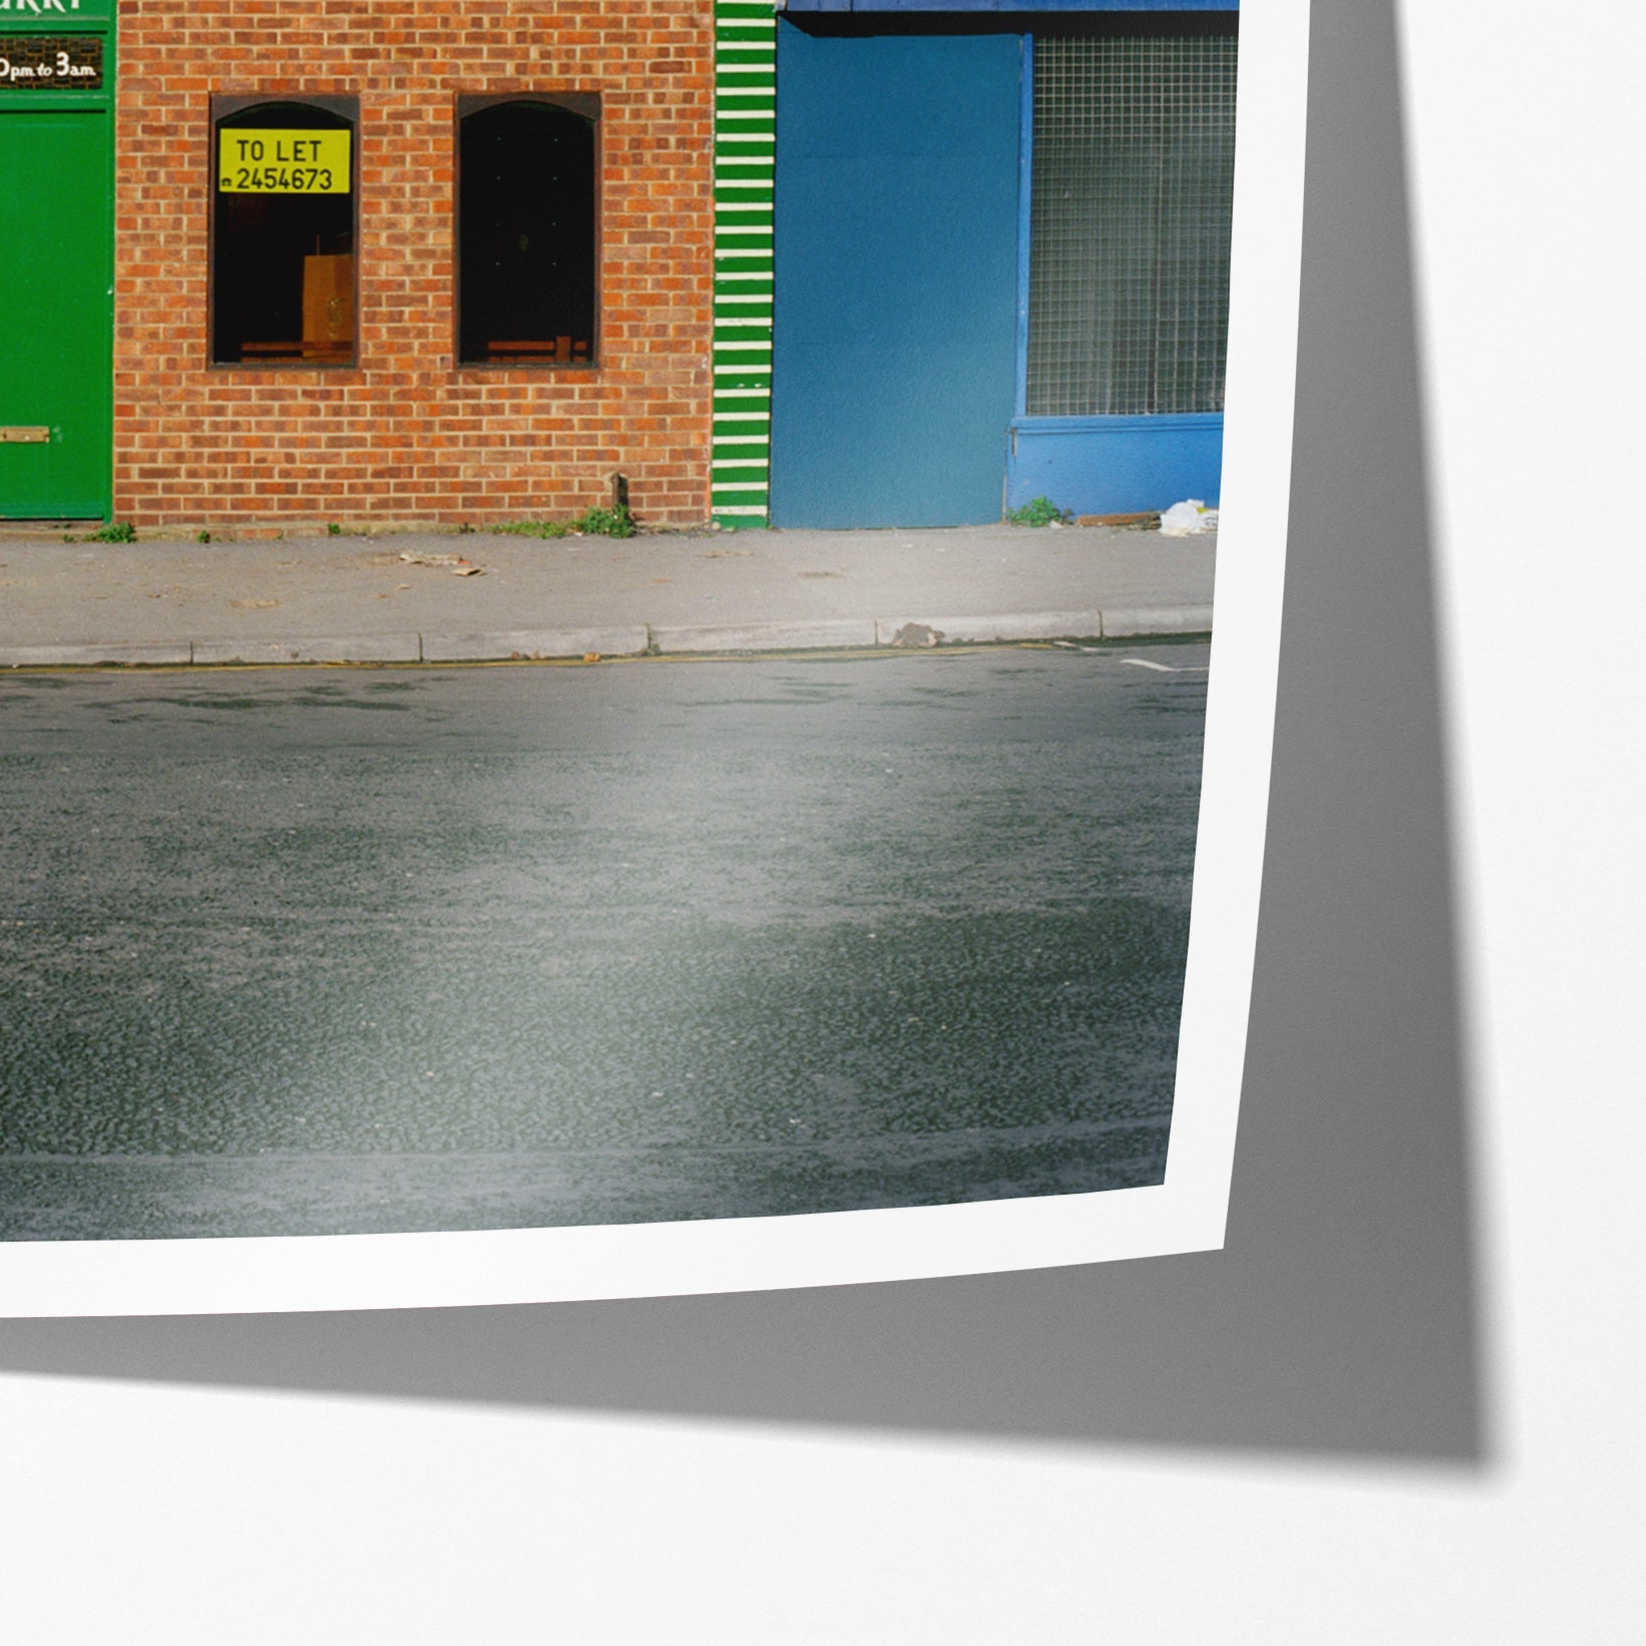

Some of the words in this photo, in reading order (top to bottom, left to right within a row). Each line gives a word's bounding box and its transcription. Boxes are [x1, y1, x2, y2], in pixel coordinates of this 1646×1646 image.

[36, 63, 53, 77] to
[237, 140, 264, 161] TO
[277, 140, 322, 162] LET
[237, 168, 332, 190] 2454673
